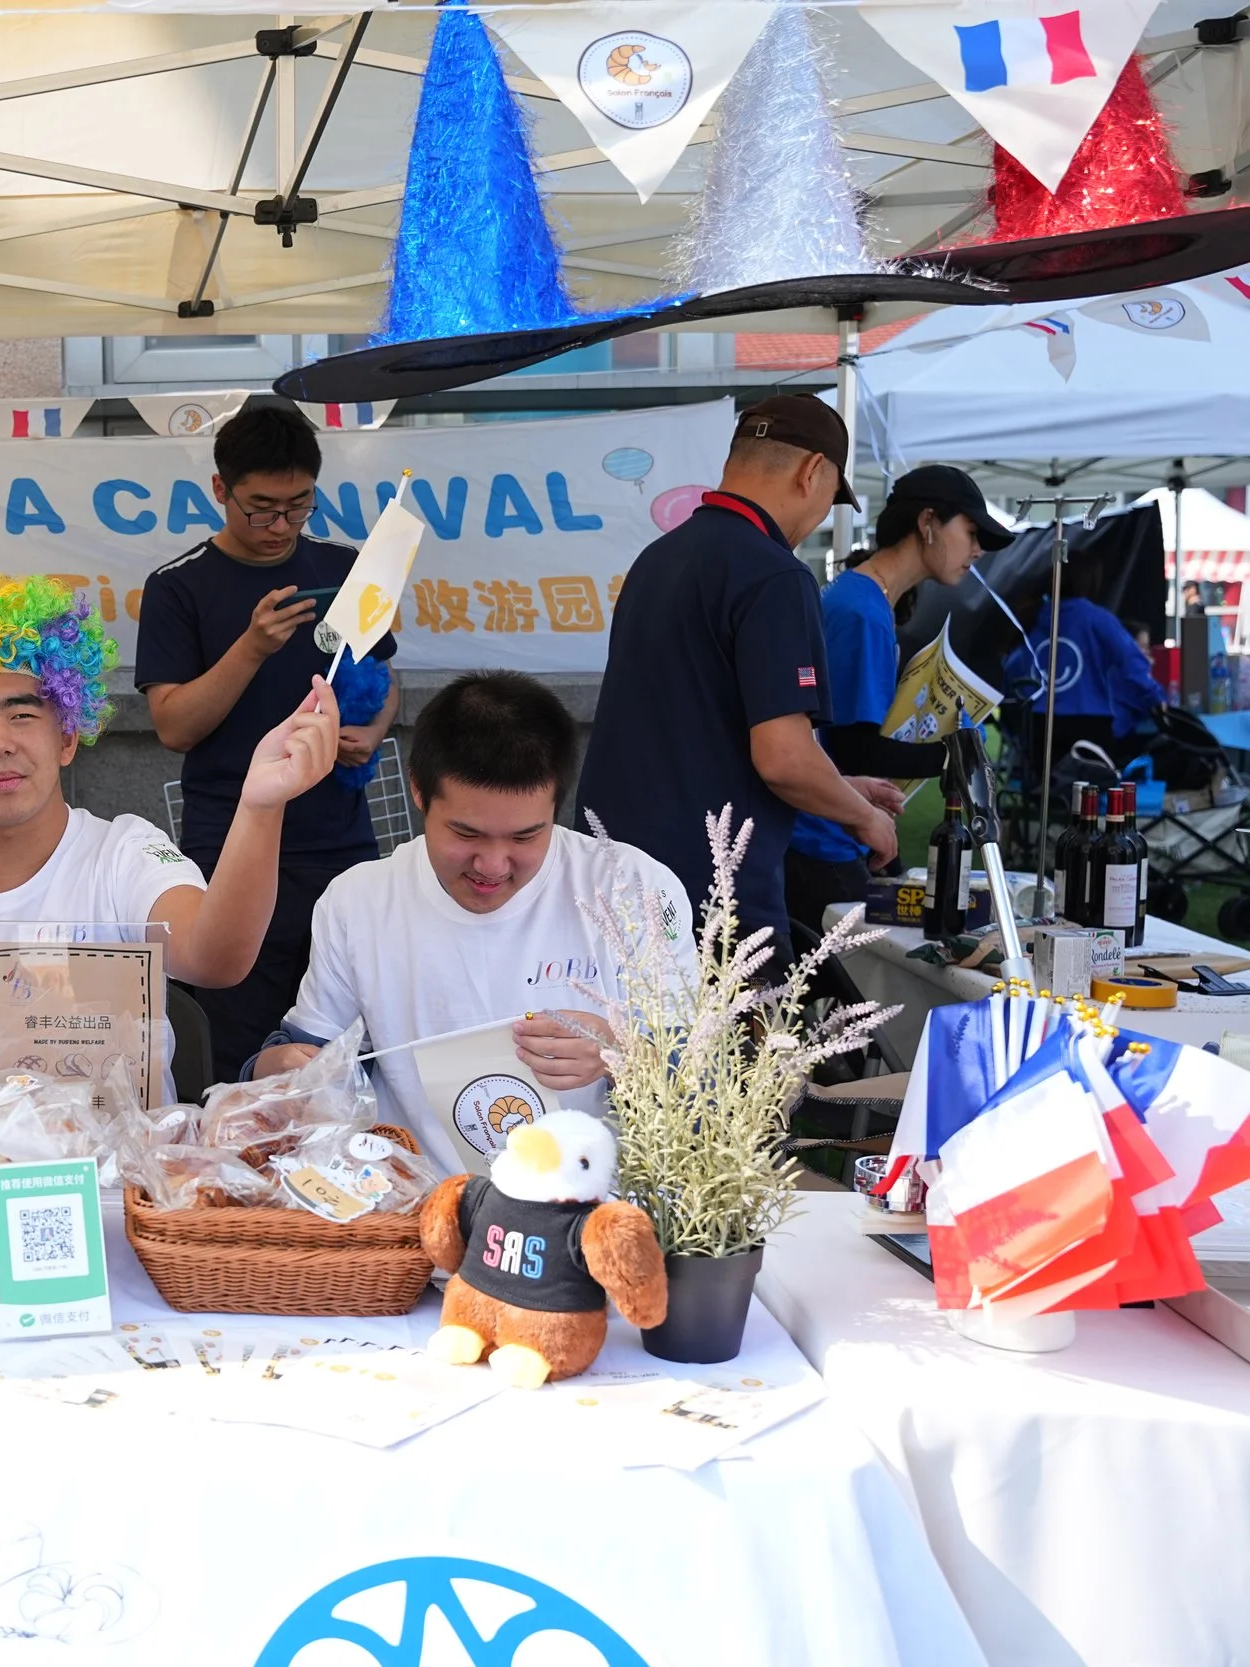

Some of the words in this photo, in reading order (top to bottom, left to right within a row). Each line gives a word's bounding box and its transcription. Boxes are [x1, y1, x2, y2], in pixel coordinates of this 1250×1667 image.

[897, 887, 927, 905] SP
[25, 1015, 112, 1029] 睿丰公益出品
[473, 1100, 485, 1122] Salon
[480, 1121, 497, 1149] Françai
[0, 1173, 85, 1191] 推荐使用微信支付
[39, 1311, 90, 1325] 微信支付
